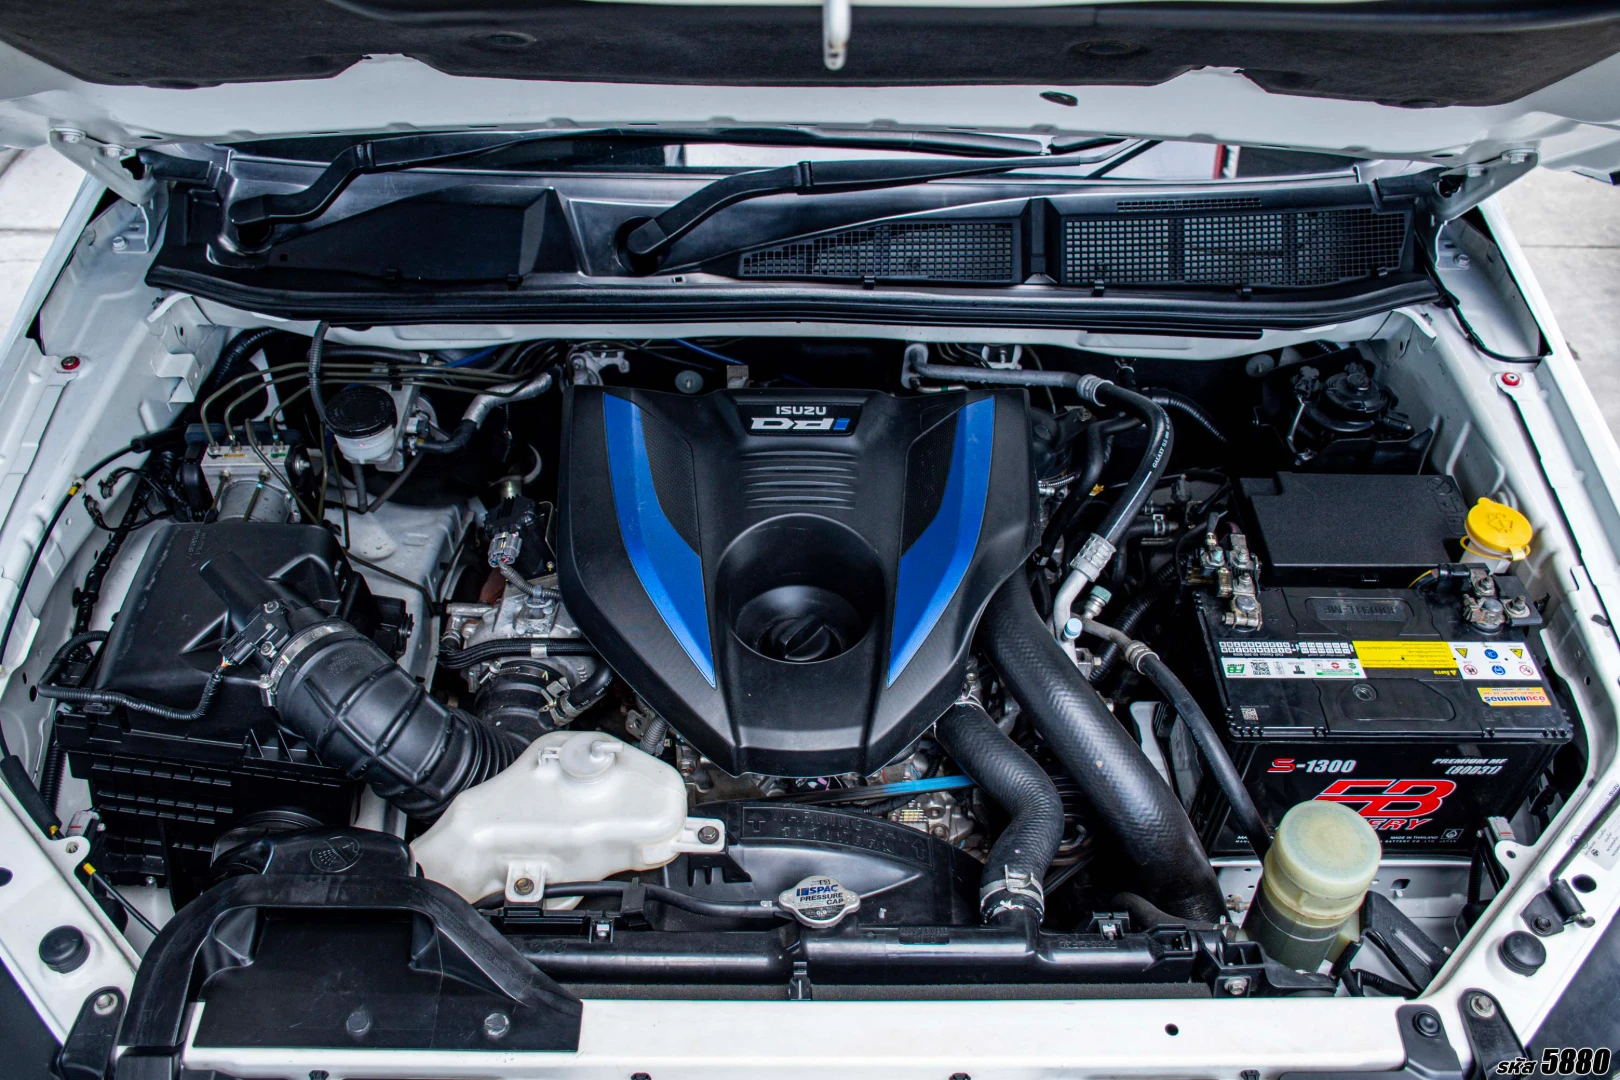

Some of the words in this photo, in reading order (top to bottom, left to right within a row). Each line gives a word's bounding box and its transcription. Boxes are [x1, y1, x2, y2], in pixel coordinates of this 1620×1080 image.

[775, 405, 827, 415] ISUZU
[1152, 446, 1164, 468] GALAXY
[1267, 757, 1357, 774] S-1300
[1444, 765, 1503, 775] (80D31)
[799, 892, 844, 902] PRESSURE
